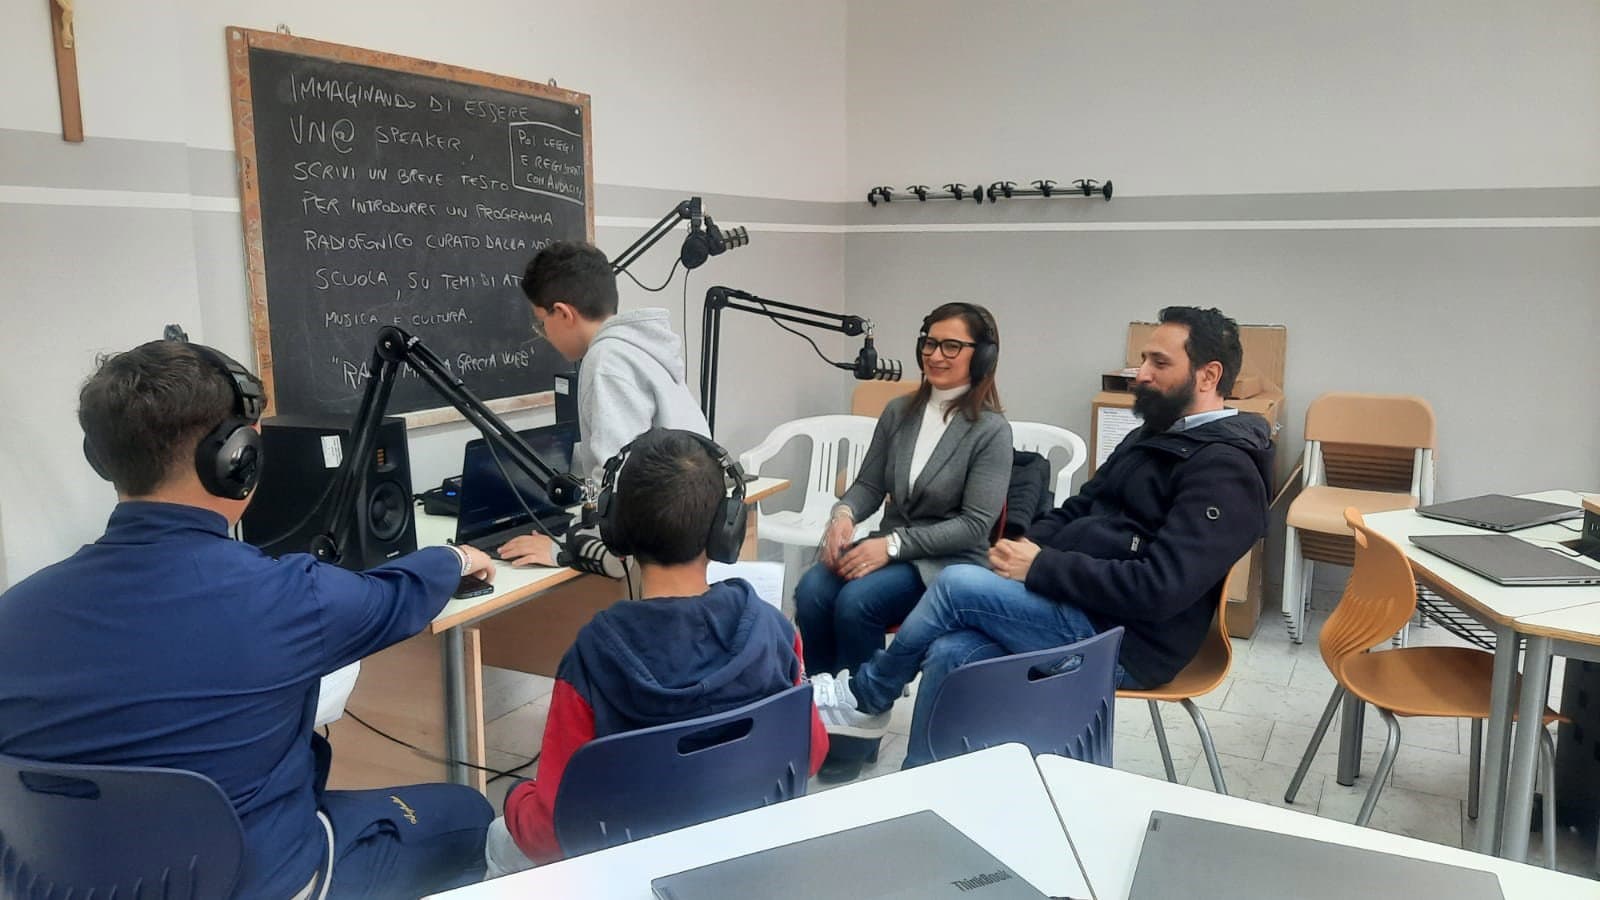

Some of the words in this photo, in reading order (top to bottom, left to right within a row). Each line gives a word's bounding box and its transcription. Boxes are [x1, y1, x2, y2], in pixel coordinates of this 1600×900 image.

[290, 72, 417, 109] IMMAGINANDO
[430, 95, 451, 112] DI
[464, 100, 529, 123] ESSERE
[293, 161, 355, 181] SCRIVI
[368, 167, 387, 180] UN
[397, 168, 444, 184] BREVE
[302, 190, 341, 215] PER
[351, 197, 437, 216] INTRODURRE
[446, 205, 468, 218] UN
[475, 203, 553, 225] PROGRAMMA
[303, 229, 414, 251] RADIOFONICO
[425, 232, 481, 250] CURATO
[485, 234, 526, 250] DALLA
[407, 271, 430, 289] SU
[440, 273, 475, 290] TEMI
[324, 311, 379, 328] MUSICA
[393, 316, 401, 325] E
